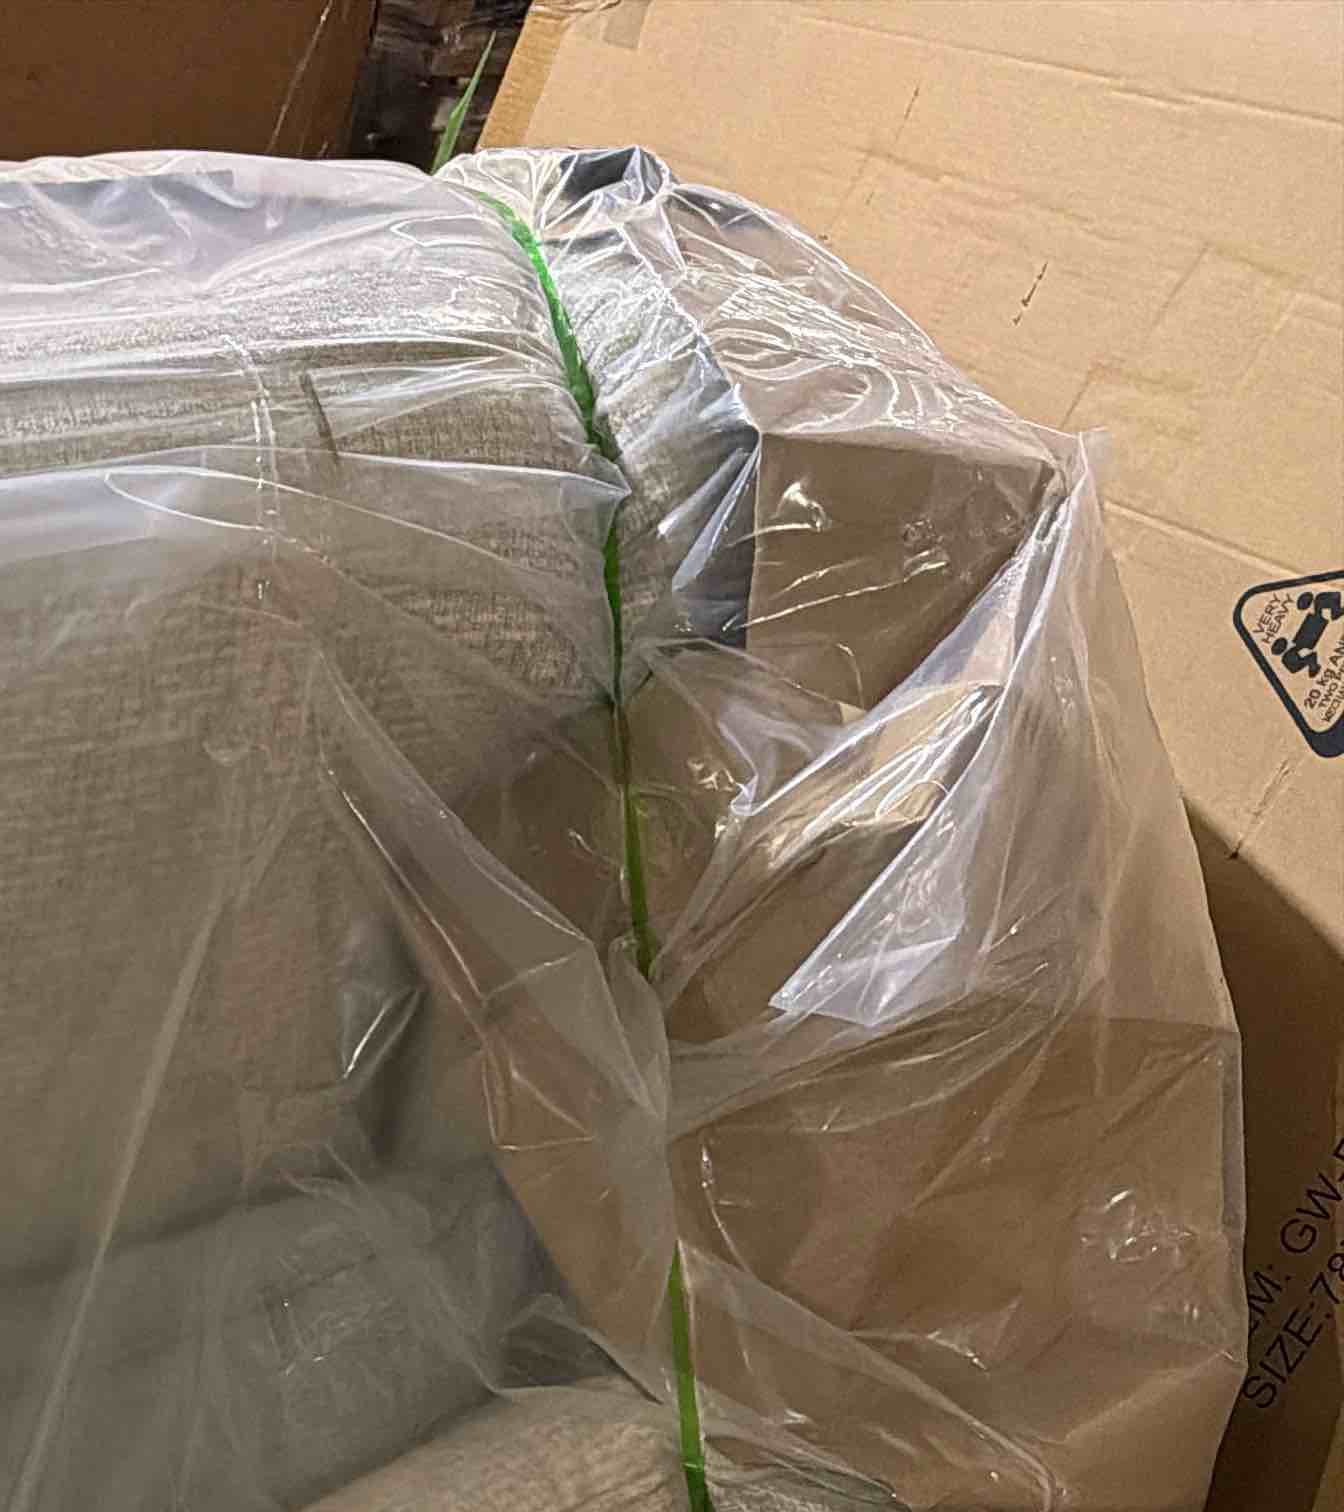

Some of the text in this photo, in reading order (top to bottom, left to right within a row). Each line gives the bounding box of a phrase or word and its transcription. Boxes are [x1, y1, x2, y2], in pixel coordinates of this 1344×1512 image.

[1253, 593, 1280, 633] VERY
[1262, 593, 1294, 644] HEAVY
[1304, 689, 1321, 708] 20
[1316, 668, 1336, 687] kg
[1243, 1241, 1344, 1409] SIZE:78
